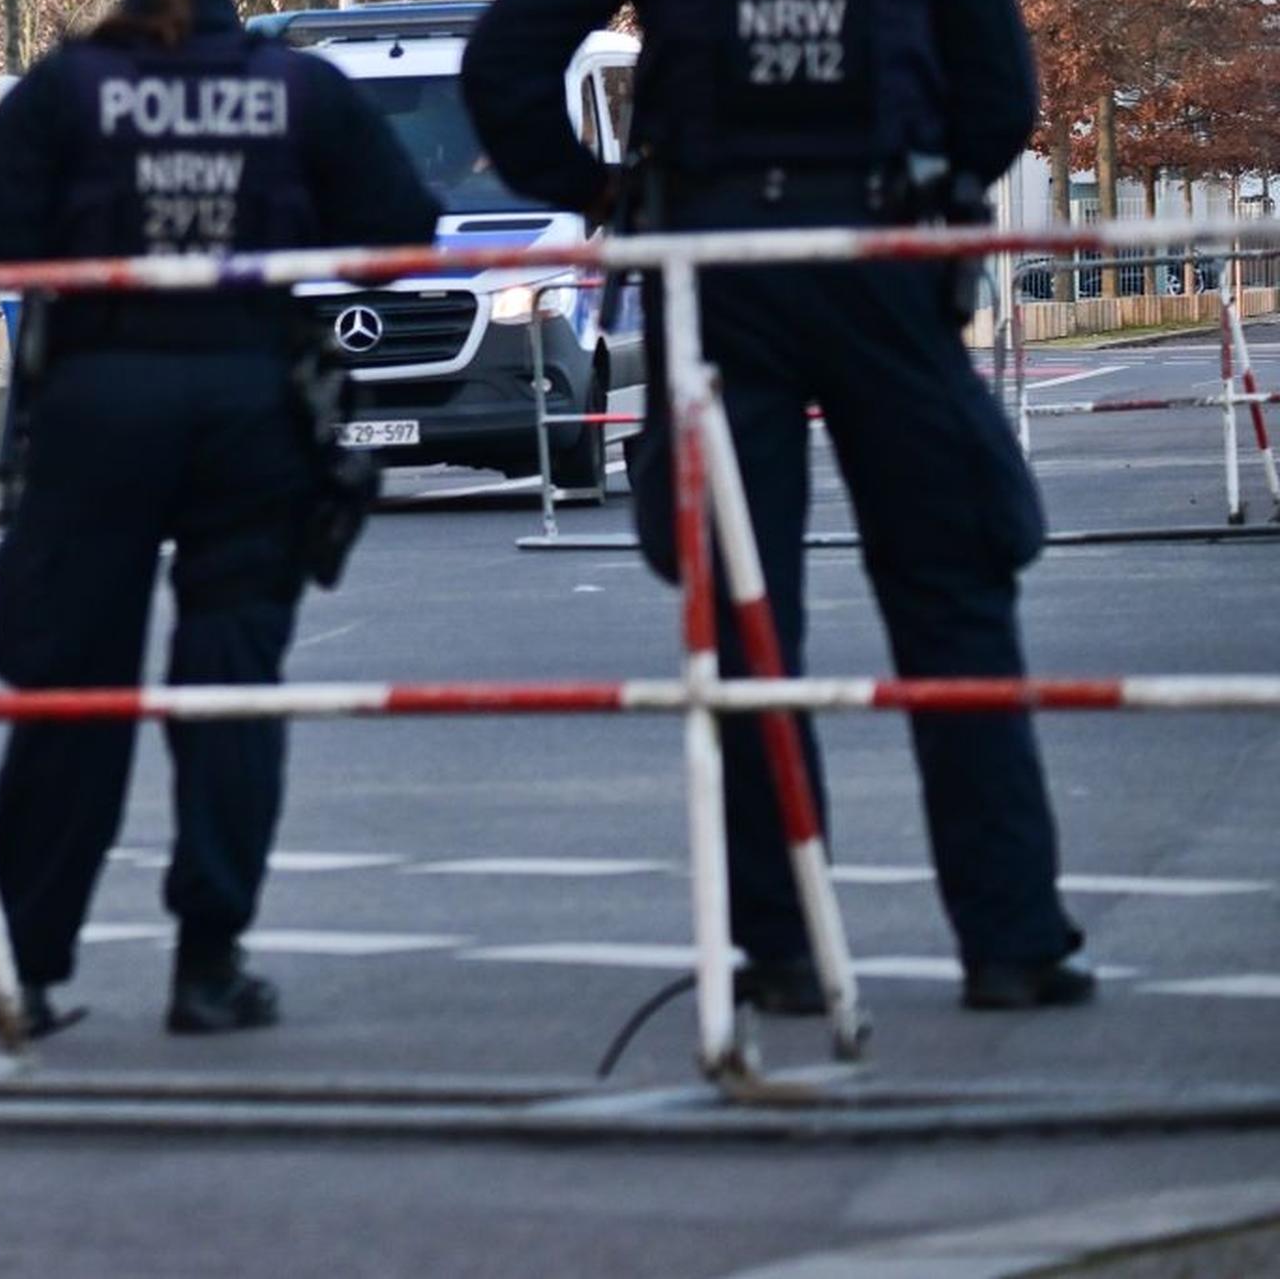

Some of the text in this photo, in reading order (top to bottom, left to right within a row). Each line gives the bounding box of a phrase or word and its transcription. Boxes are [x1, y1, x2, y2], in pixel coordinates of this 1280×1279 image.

[749, 42, 844, 82] 2912
[100, 77, 289, 136] POLIZEI
[137, 153, 244, 193] NRW
[144, 197, 237, 237] 2912
